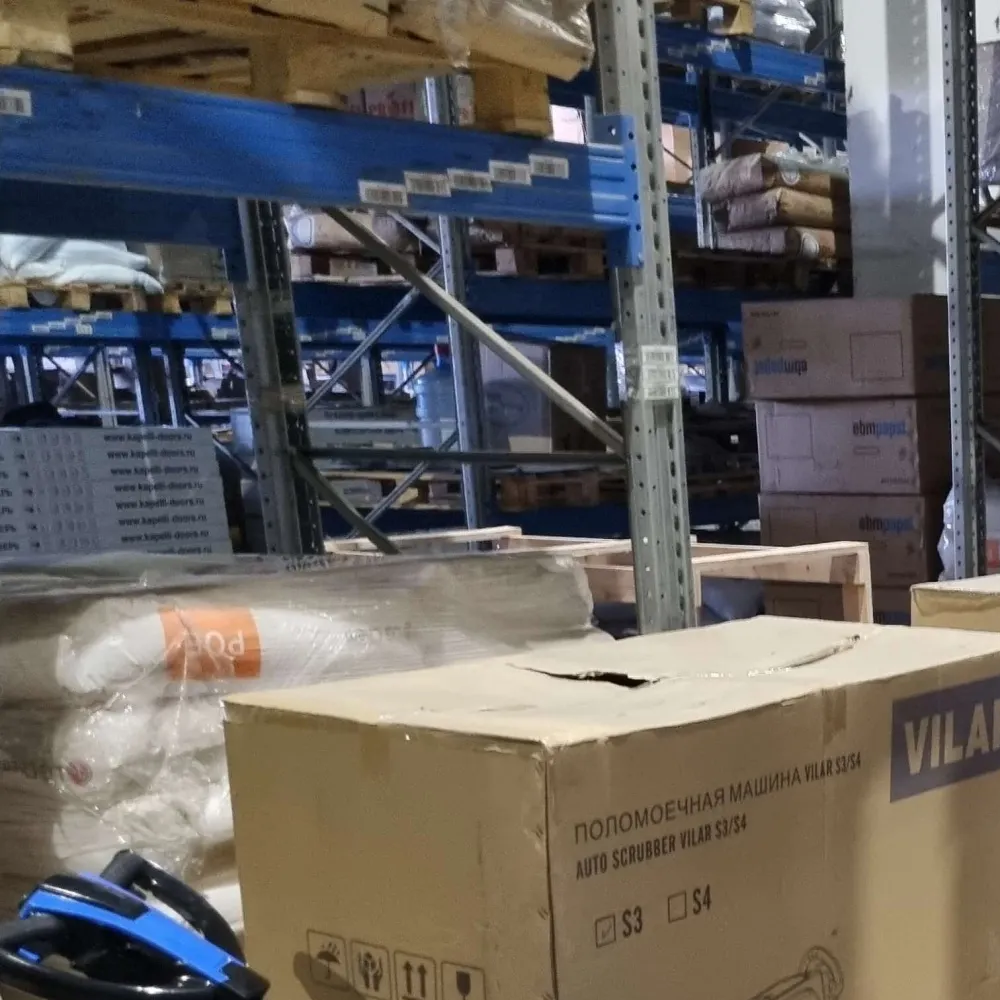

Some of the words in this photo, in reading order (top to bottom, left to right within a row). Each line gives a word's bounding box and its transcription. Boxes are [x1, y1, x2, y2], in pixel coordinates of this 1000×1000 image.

[574, 787, 725, 844] ПОЛОМОЕЧНАЯ
[729, 767, 801, 803] МАШИНА
[804, 758, 833, 783] VILAR
[835, 752, 861, 775] S3/S4
[576, 855, 608, 881] AUTO
[612, 835, 676, 870] SCRUBBER
[680, 824, 712, 850] VILAR
[715, 813, 747, 840] S3/S4
[622, 905, 643, 938] S3
[692, 884, 712, 915] S4
